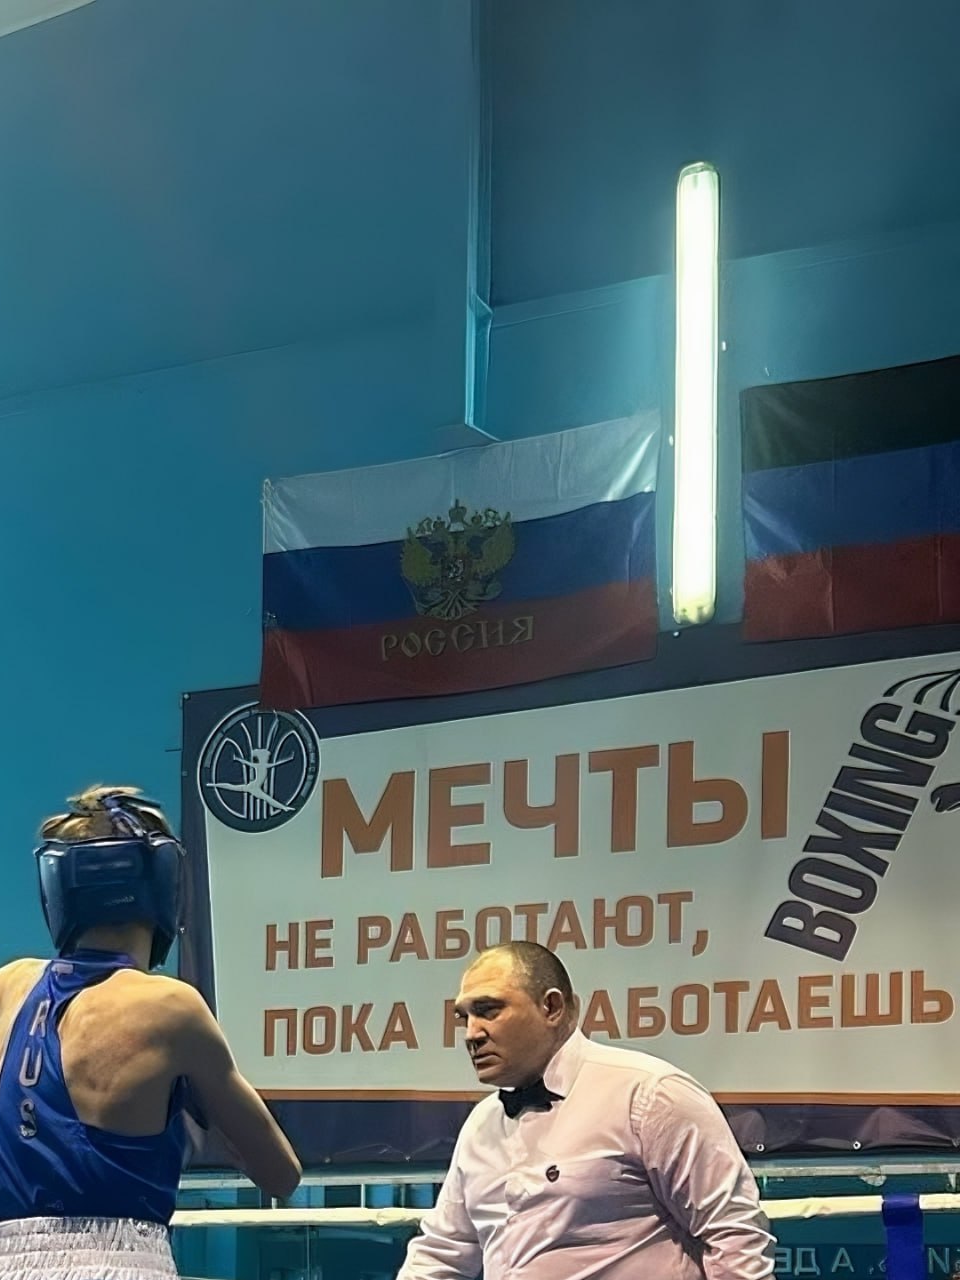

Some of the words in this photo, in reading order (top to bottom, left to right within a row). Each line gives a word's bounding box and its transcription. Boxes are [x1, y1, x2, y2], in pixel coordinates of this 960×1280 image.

[381, 615, 534, 661] РОССИЯ
[321, 731, 789, 878] МЕЧТЫ
[764, 702, 956, 962] BOXING
[265, 919, 334, 971] НЕ
[356, 891, 709, 964] РАБОТАЮТ,
[19, 1000, 51, 1138] RUS
[264, 1001, 419, 1056] ПОКА
[573, 970, 954, 1040] АБОТАЕШЬ
